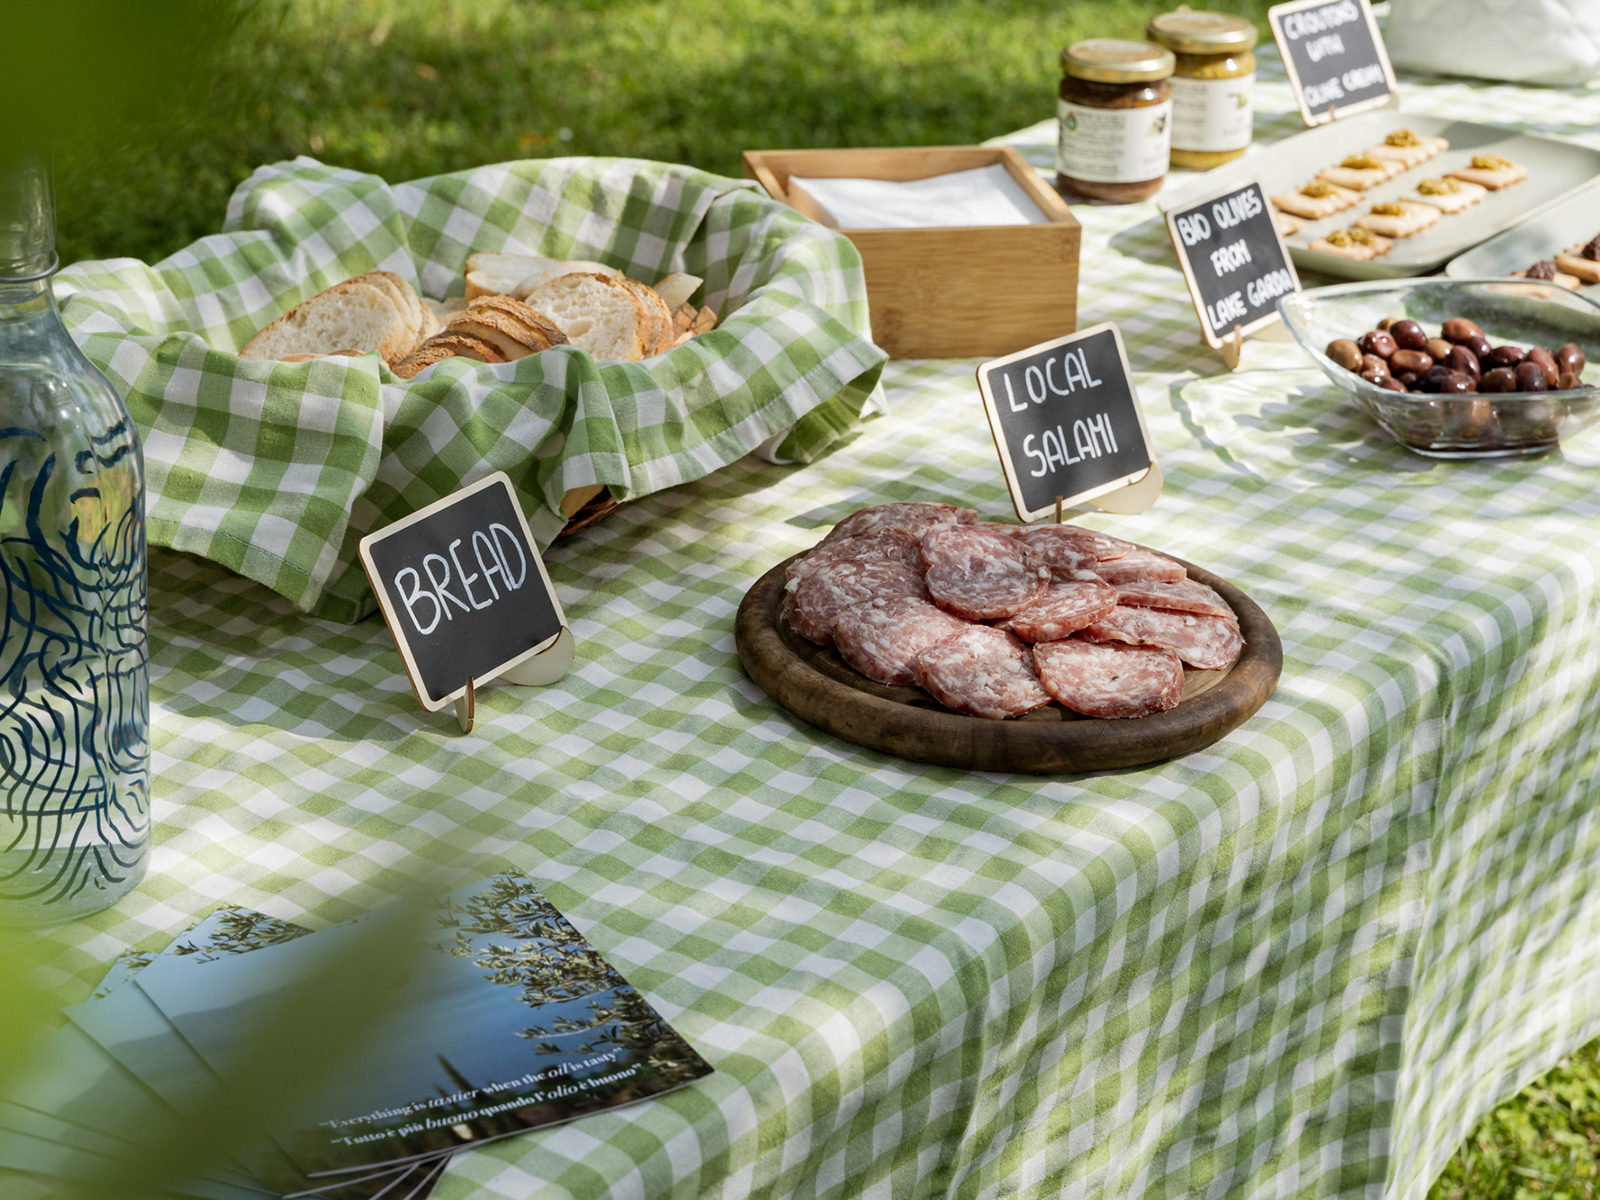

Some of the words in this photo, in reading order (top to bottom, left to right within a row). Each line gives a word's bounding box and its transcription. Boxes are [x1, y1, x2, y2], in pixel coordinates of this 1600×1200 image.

[1177, 213, 1211, 246] BIO
[1212, 188, 1262, 229] OLIVES
[1210, 238, 1252, 277] FROM
[1207, 291, 1247, 330] LAKE
[1247, 268, 1294, 307] GARDA
[1003, 347, 1102, 412] LOCAL
[1023, 412, 1118, 477] SALAMI
[394, 523, 526, 635] BREAD
[425, 1109, 479, 1130] buono
[479, 1092, 535, 1118] quando
[429, 1088, 479, 1109] tastier
[481, 1079, 522, 1096] when
[521, 1070, 548, 1085] the
[547, 1062, 570, 1079] oil
[569, 1060, 584, 1072] is
